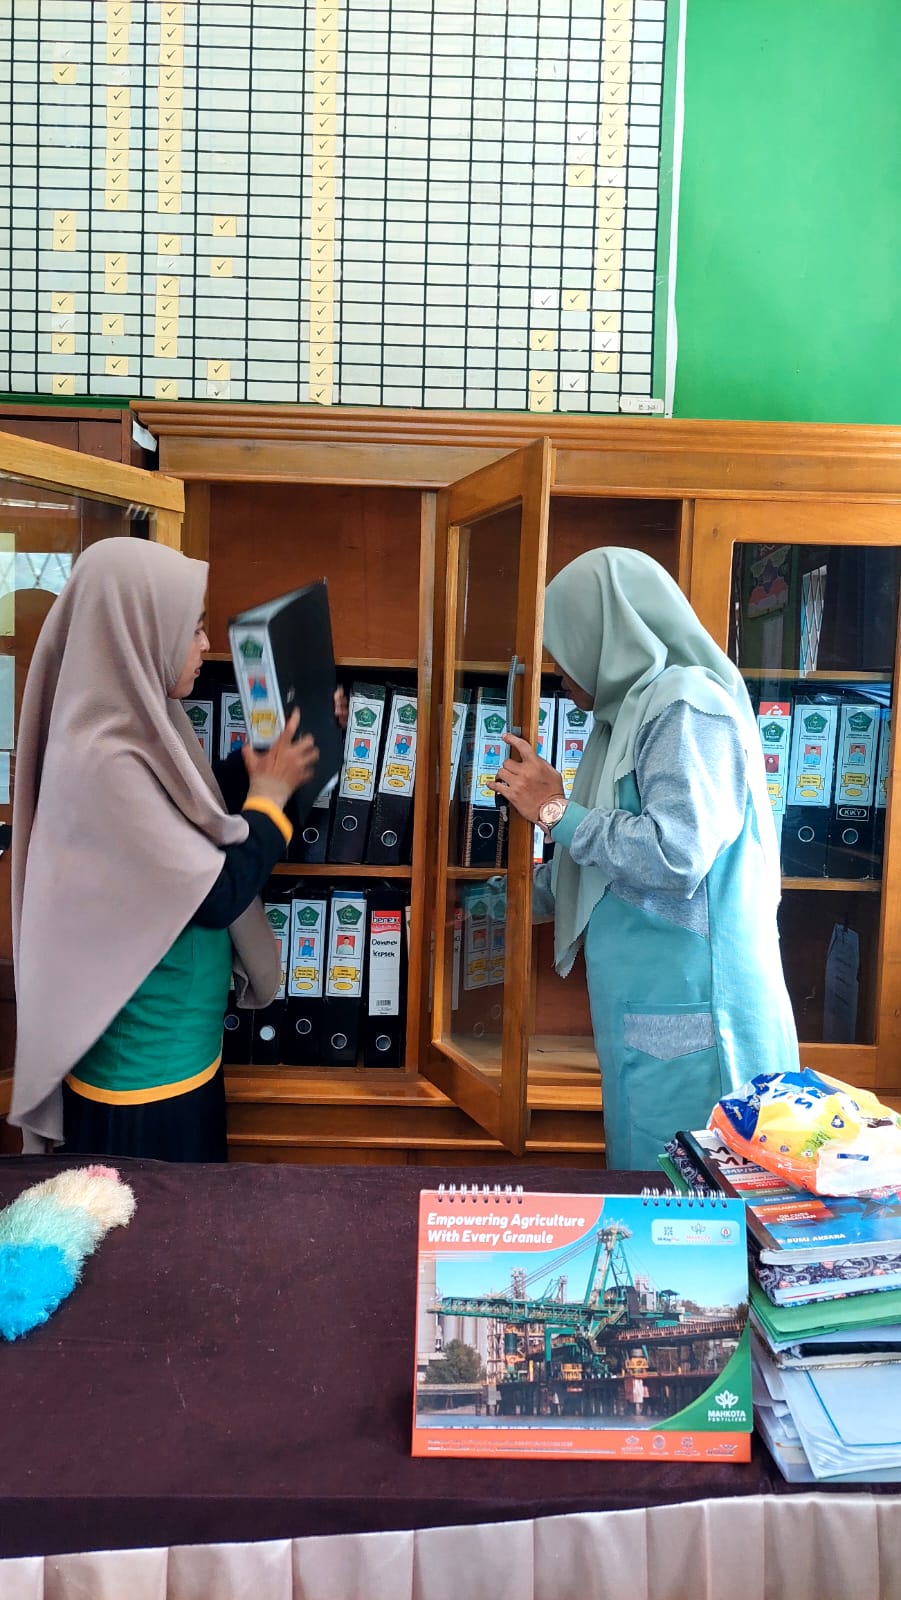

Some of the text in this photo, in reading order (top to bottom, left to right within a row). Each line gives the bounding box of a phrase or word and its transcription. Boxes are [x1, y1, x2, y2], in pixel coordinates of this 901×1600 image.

[427, 1212, 585, 1229] Empowering Agriculture
[428, 1230, 554, 1246] With Every Granule
[786, 1233, 846, 1244] BUMI AKSARA
